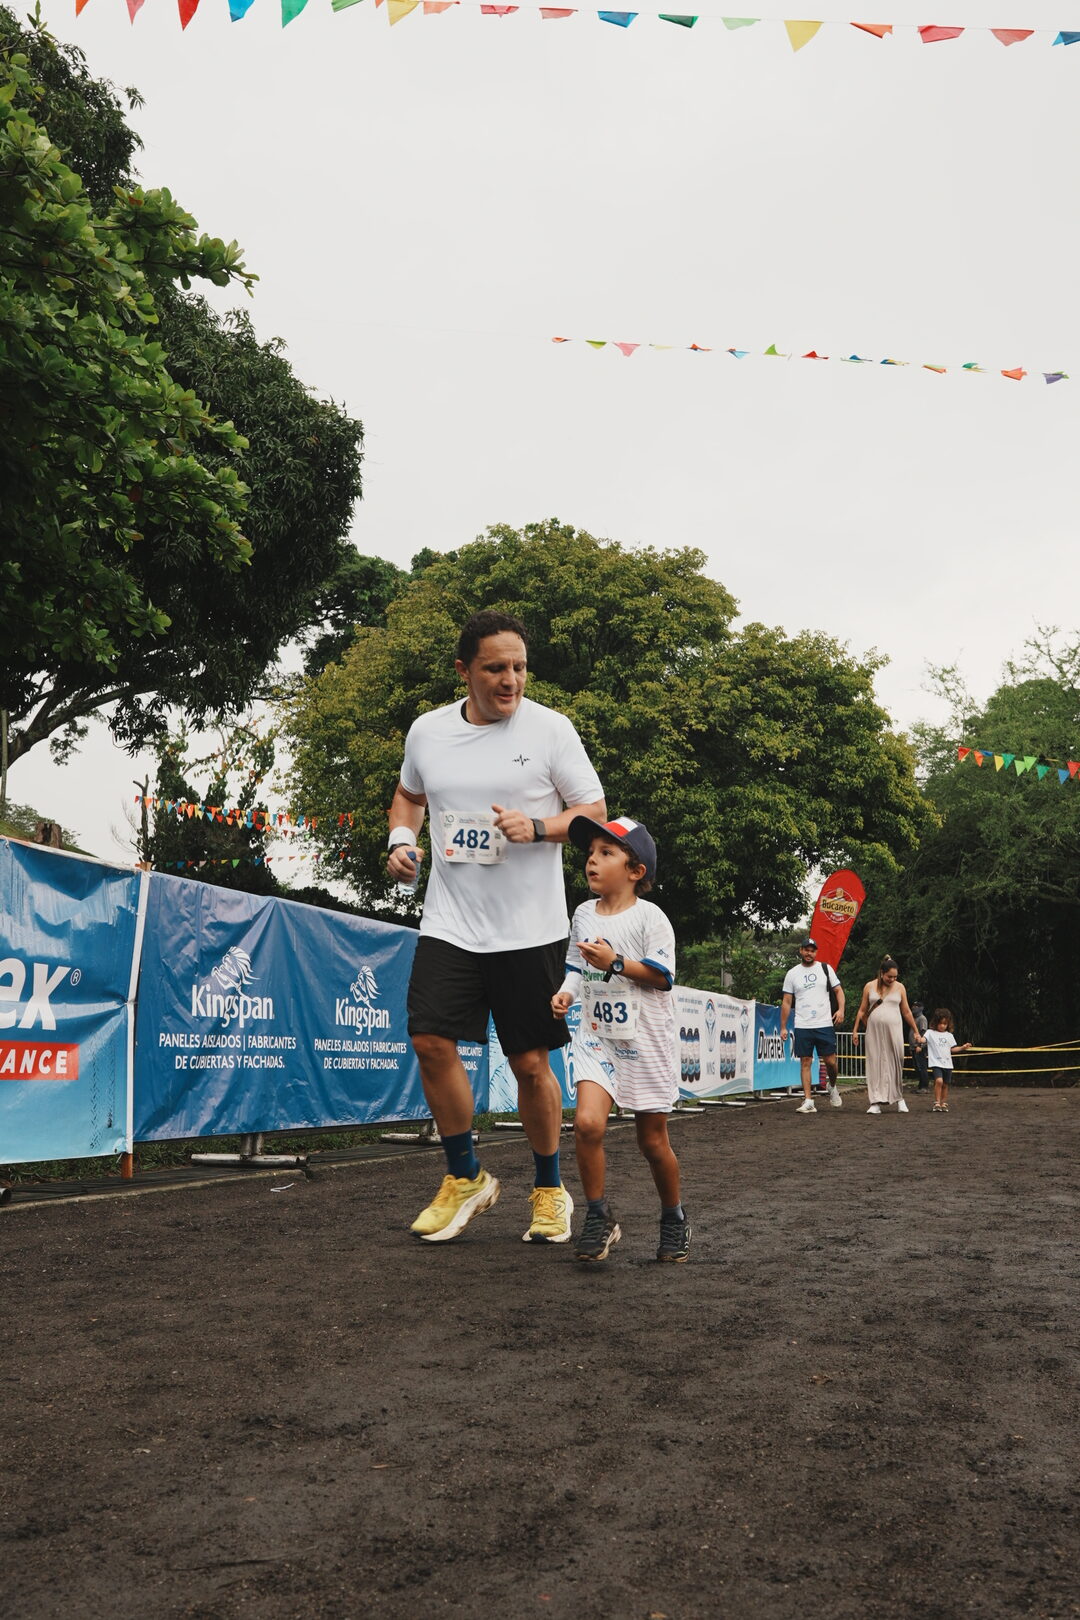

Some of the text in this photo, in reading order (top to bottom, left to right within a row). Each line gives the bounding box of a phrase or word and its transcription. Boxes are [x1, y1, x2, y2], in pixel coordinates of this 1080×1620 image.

[452, 828, 490, 850] 482
[821, 898, 855, 914] Bucanero
[191, 984, 274, 1029] Kingspan
[335, 998, 391, 1036] Kingspan
[593, 1001, 628, 1024] 483
[159, 1033, 297, 1050] PANELES AISLADOS FABRICANTES
[314, 1038, 407, 1054] PANELES AISLADOS FABRICANTES
[757, 1027, 785, 1060] Duratex
[0, 1048, 68, 1074] ANCE
[175, 1055, 286, 1070] DE CUBIERTAS Y FACHADAS.
[323, 1057, 399, 1070] DE CUBIERTAS Y FACHADAS.
